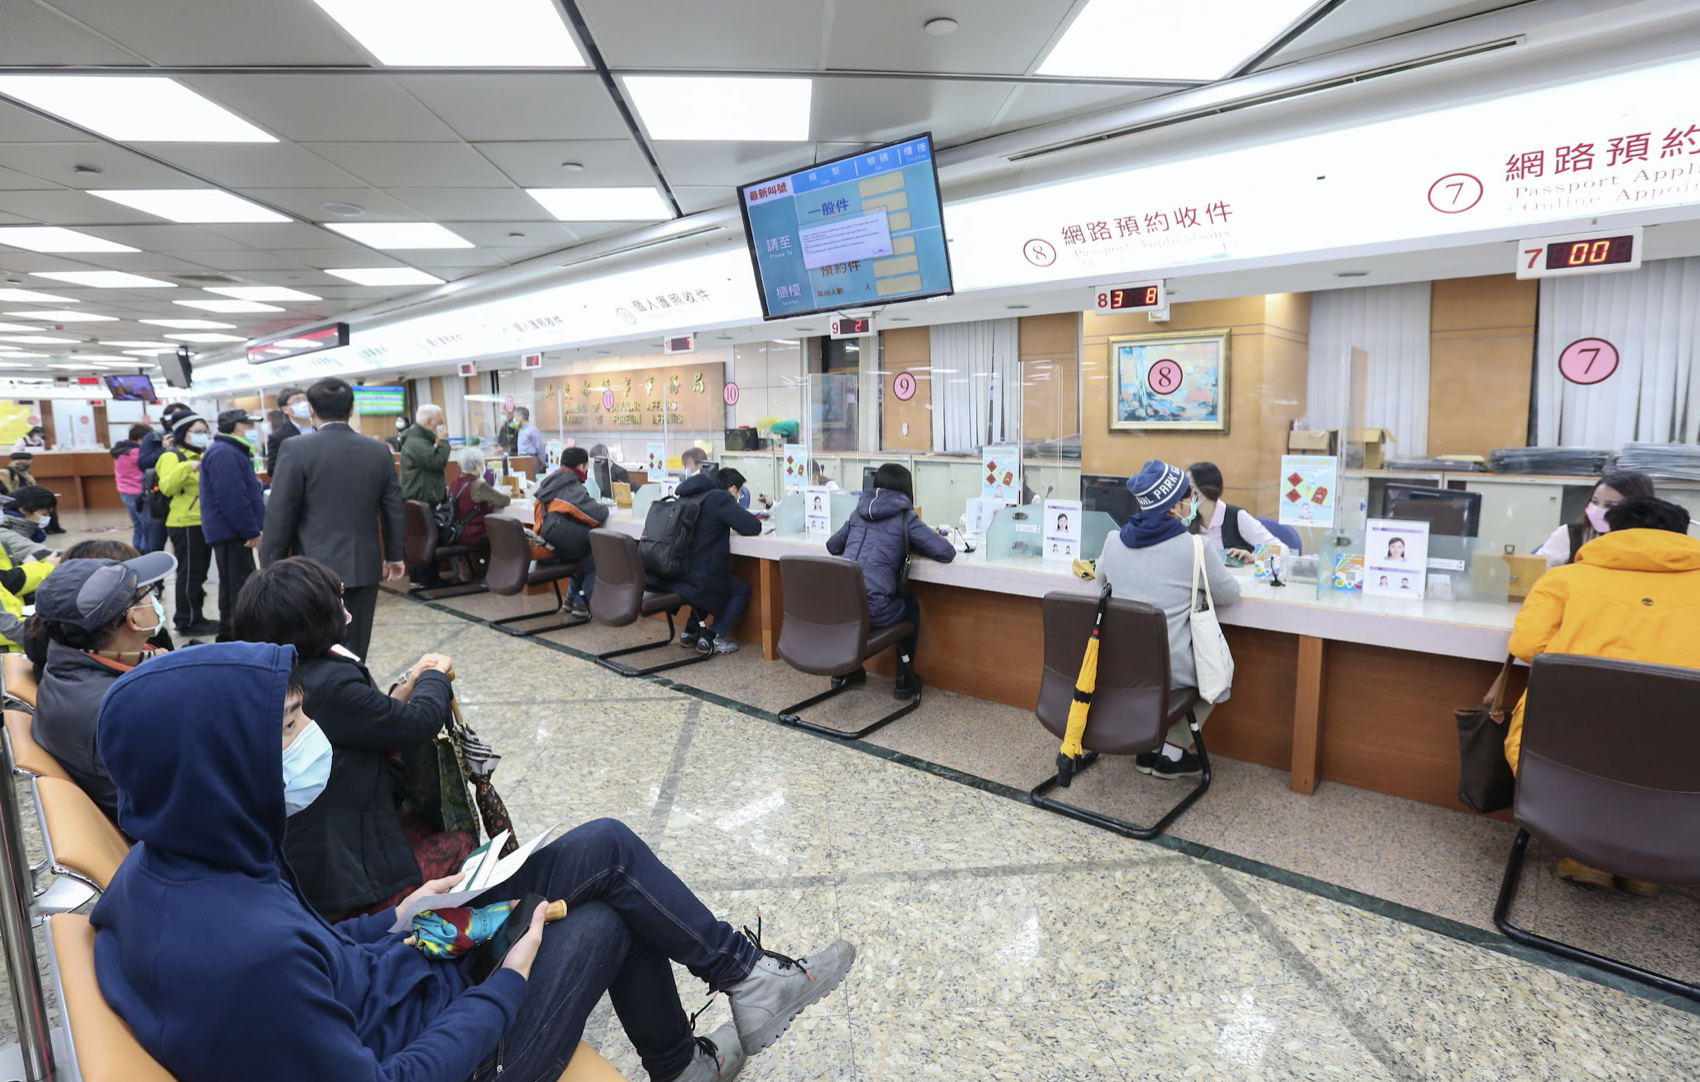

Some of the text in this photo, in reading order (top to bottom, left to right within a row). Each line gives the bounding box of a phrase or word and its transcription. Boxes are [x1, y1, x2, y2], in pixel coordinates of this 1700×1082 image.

[1505, 124, 1700, 182] 網路預約
[749, 181, 788, 202] 最新叫號
[1514, 163, 1700, 199] Passport Appl
[1444, 182, 1464, 205] 7
[807, 198, 850, 216] 一般件
[1061, 200, 1233, 246] 網路預約收件
[765, 235, 793, 252] 請至
[1031, 244, 1048, 262] 8
[1568, 240, 1610, 265] 00
[1524, 248, 1543, 269] 7
[865, 283, 872, 291] 人
[1097, 293, 1108, 308] 8
[832, 322, 839, 334] 9
[854, 319, 862, 332] 2
[1577, 347, 1602, 375] 7
[900, 377, 910, 396] 9
[1158, 366, 1172, 388] 8
[726, 386, 737, 402] 10
[1153, 473, 1178, 500] PARK
